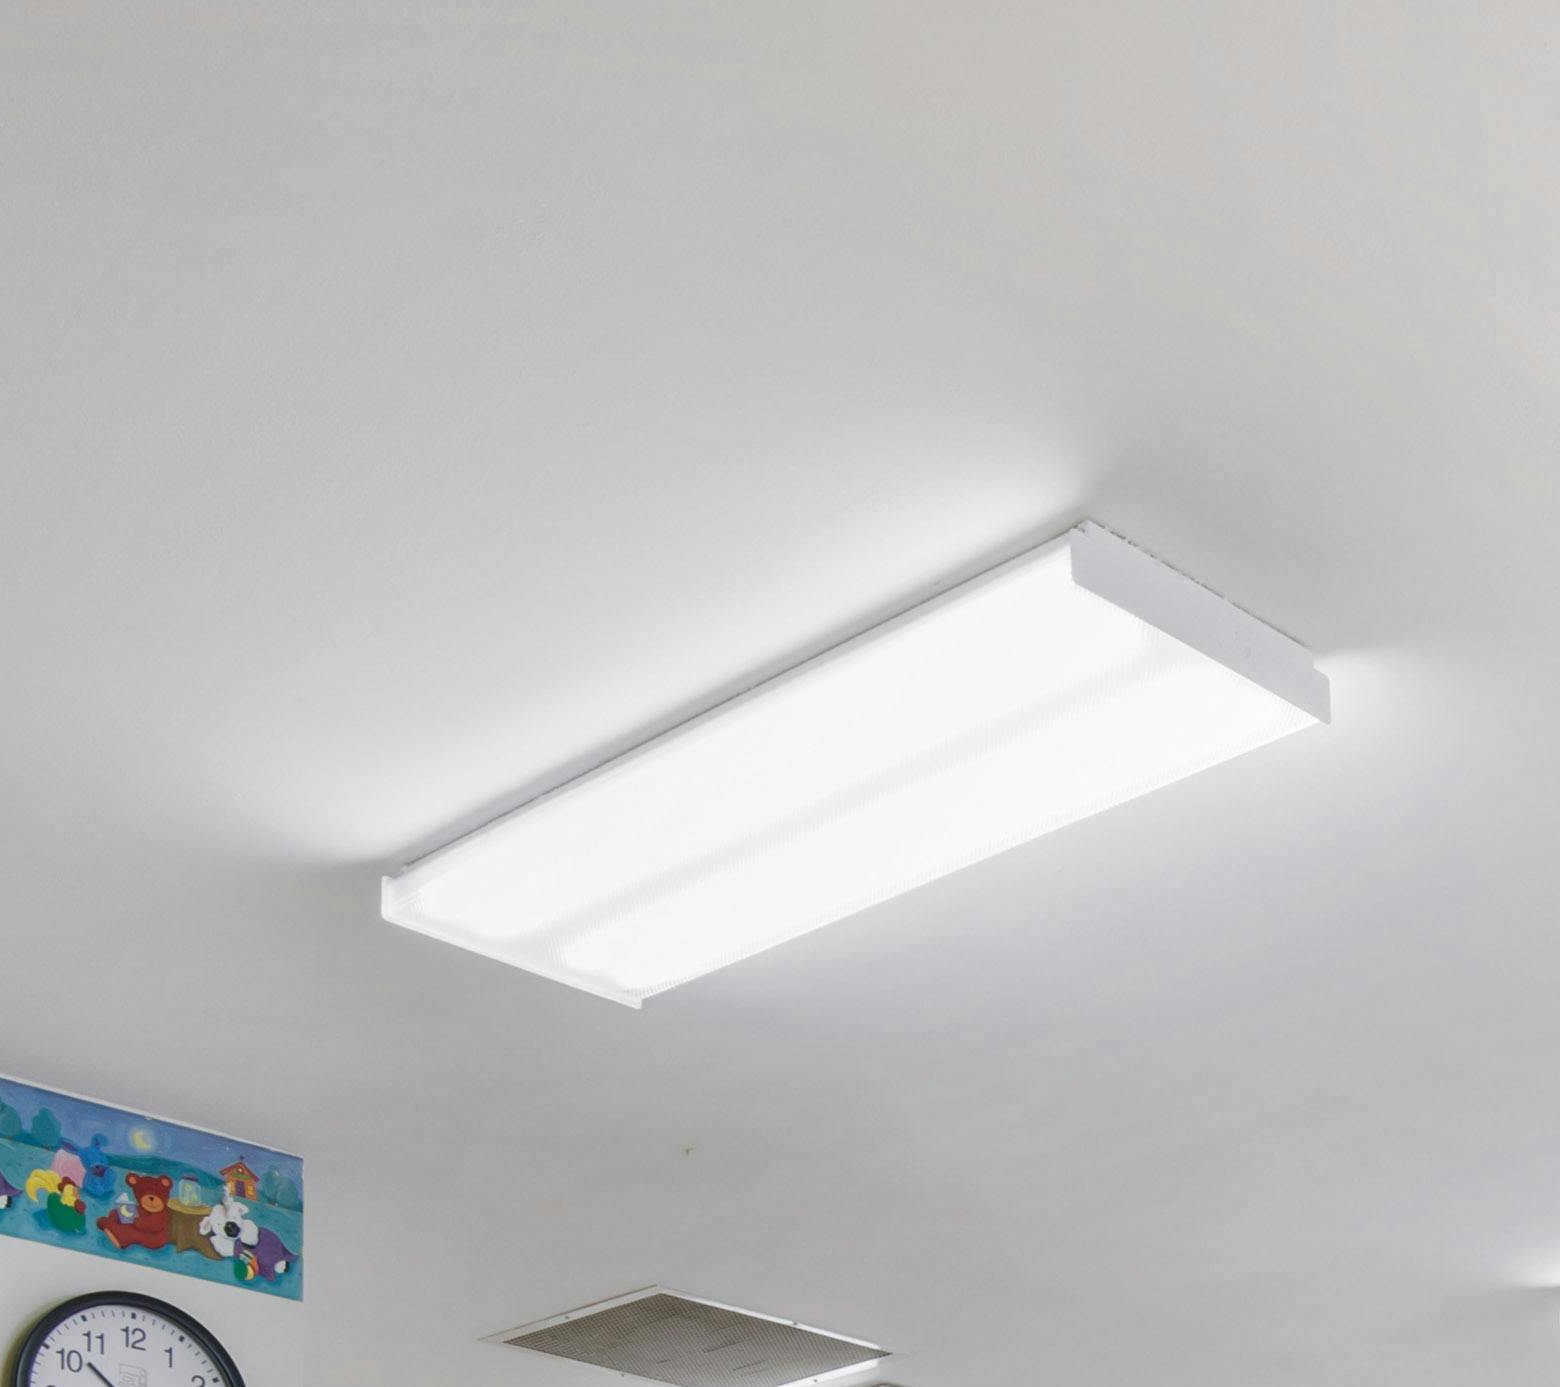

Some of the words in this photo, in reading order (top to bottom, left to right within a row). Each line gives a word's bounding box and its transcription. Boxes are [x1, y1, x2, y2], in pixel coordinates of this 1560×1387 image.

[82, 1331, 105, 1355] 11
[121, 1326, 146, 1351] 12
[56, 1348, 83, 1373] 10
[164, 1347, 173, 1368] 1
